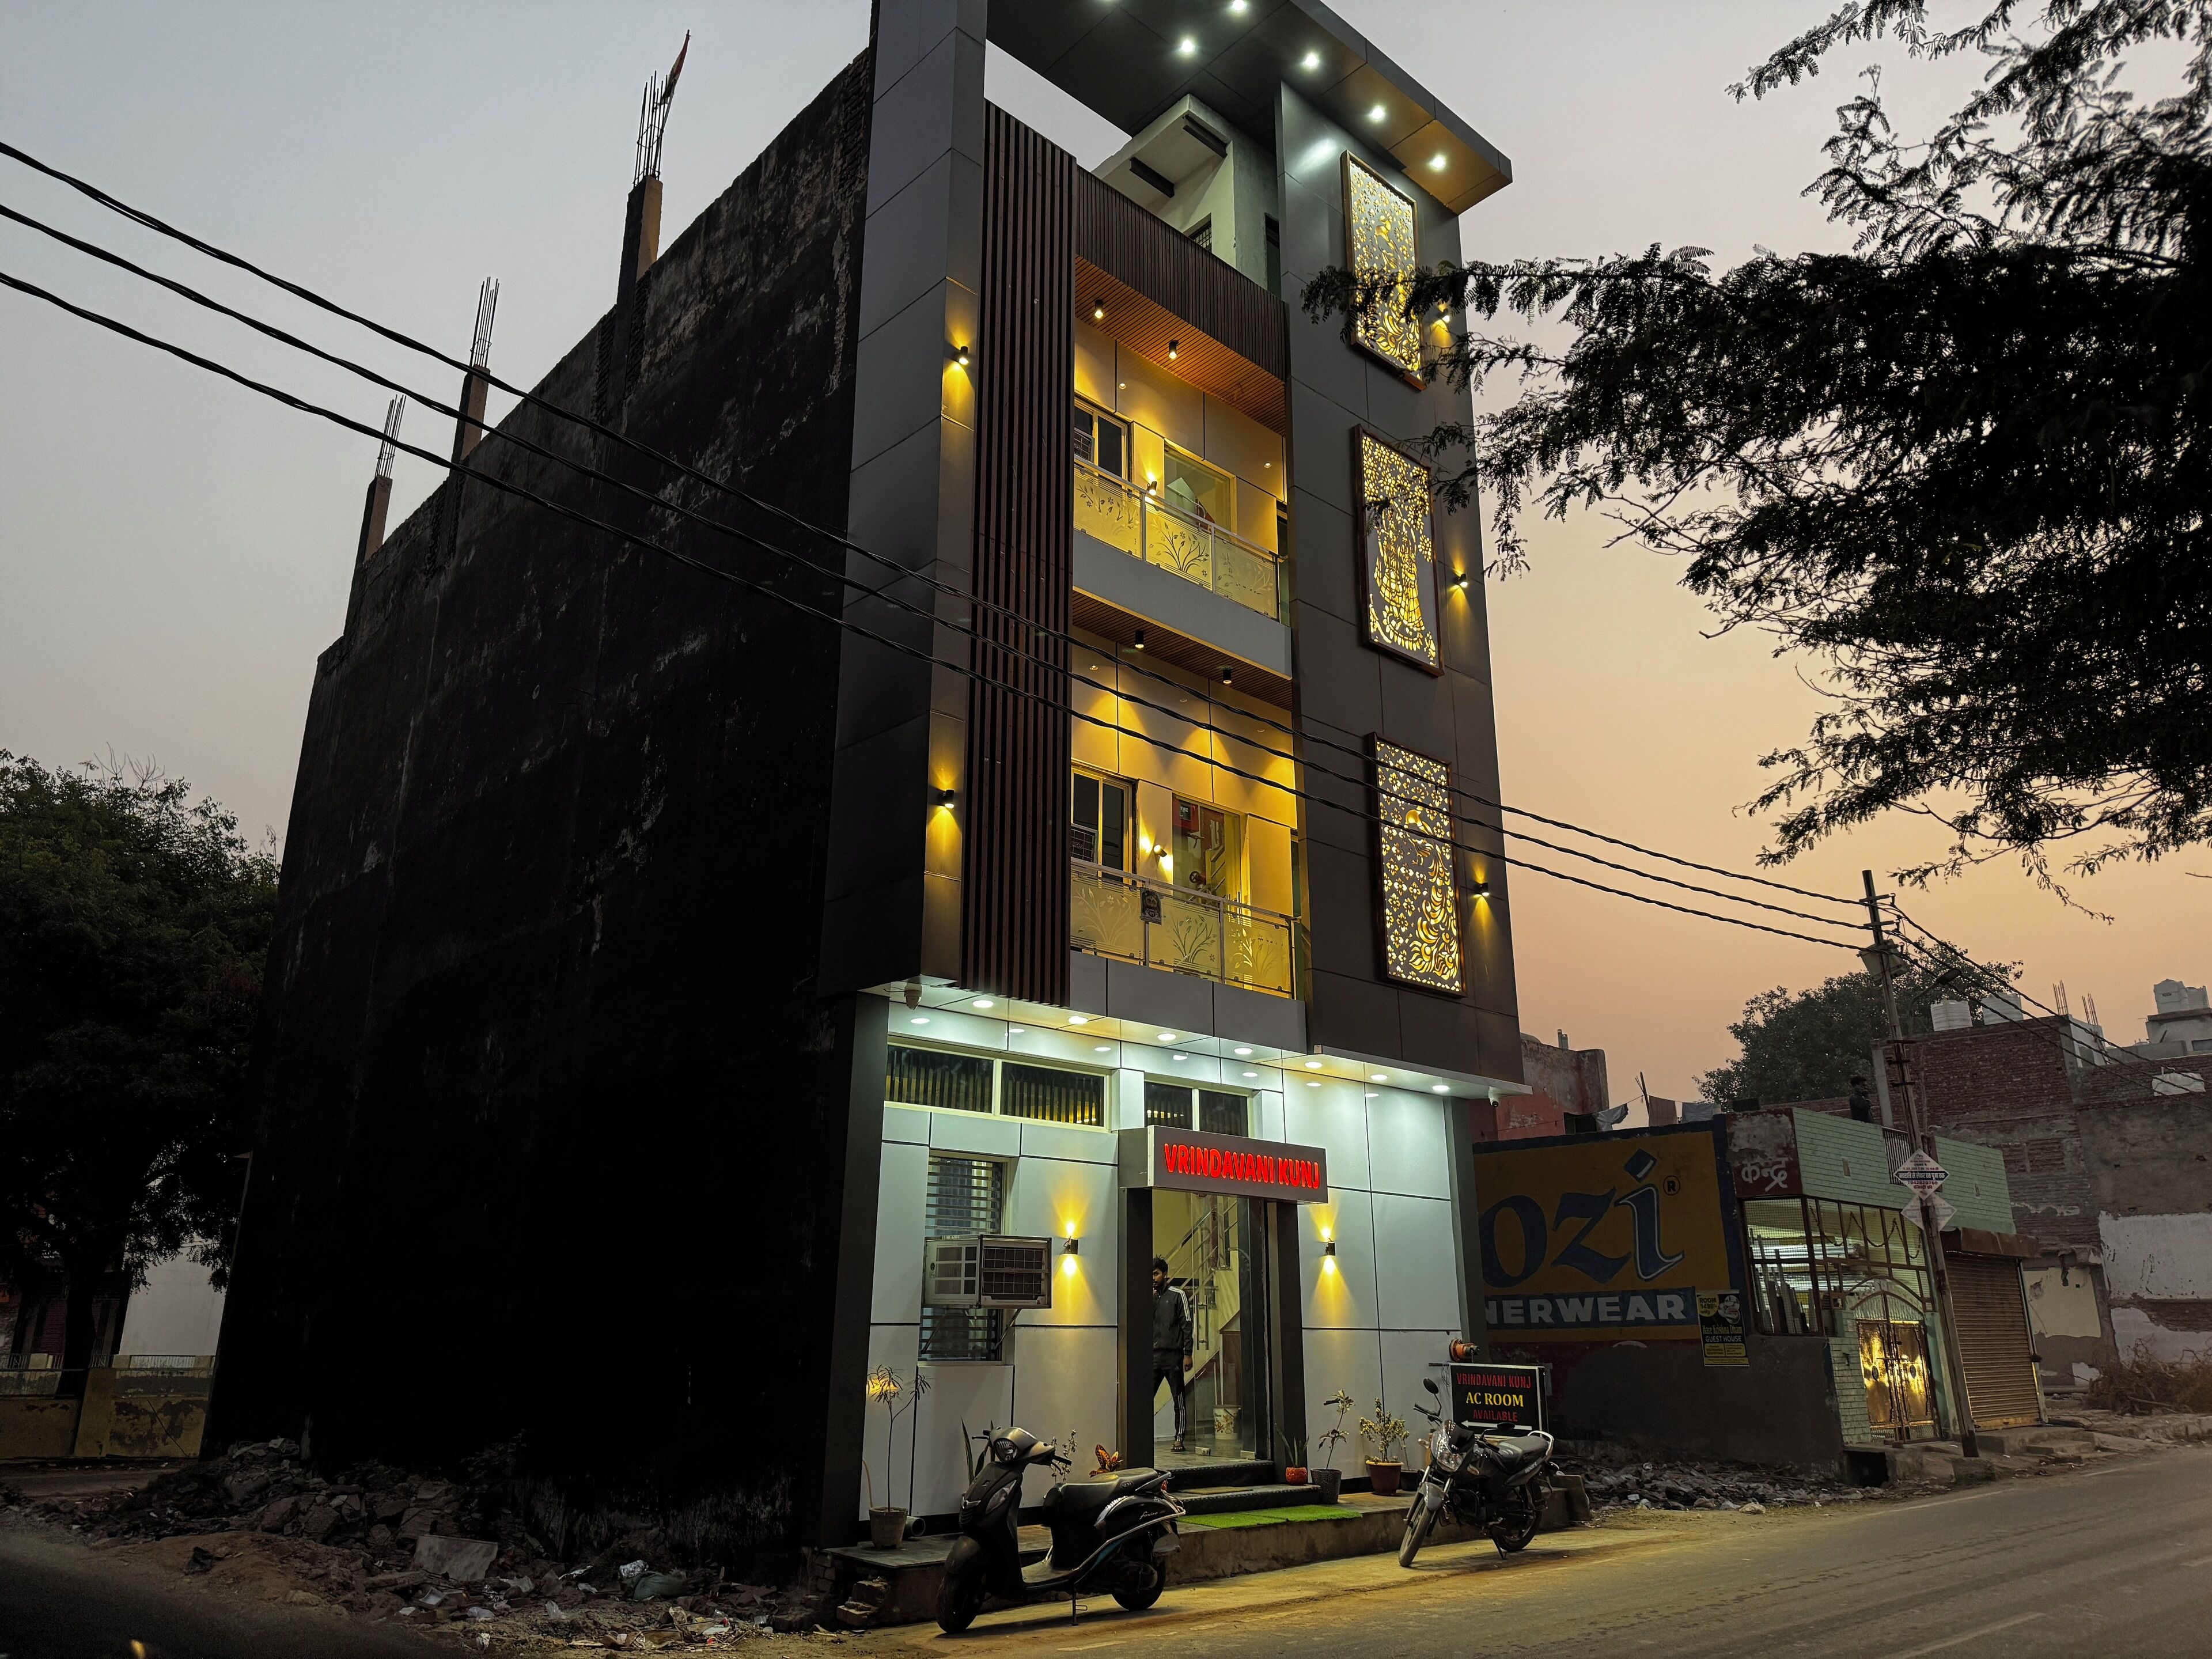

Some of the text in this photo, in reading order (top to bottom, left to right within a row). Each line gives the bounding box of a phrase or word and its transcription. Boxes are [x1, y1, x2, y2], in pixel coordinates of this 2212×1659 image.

[1164, 1143, 1320, 1189] VRINDAVANI KUNJ
[1456, 1373, 1532, 1389] VRINDAVANI KUNJ
[1465, 1392, 1524, 1407] AC ROOM
[1472, 1409, 1518, 1422] AVAILABLE
